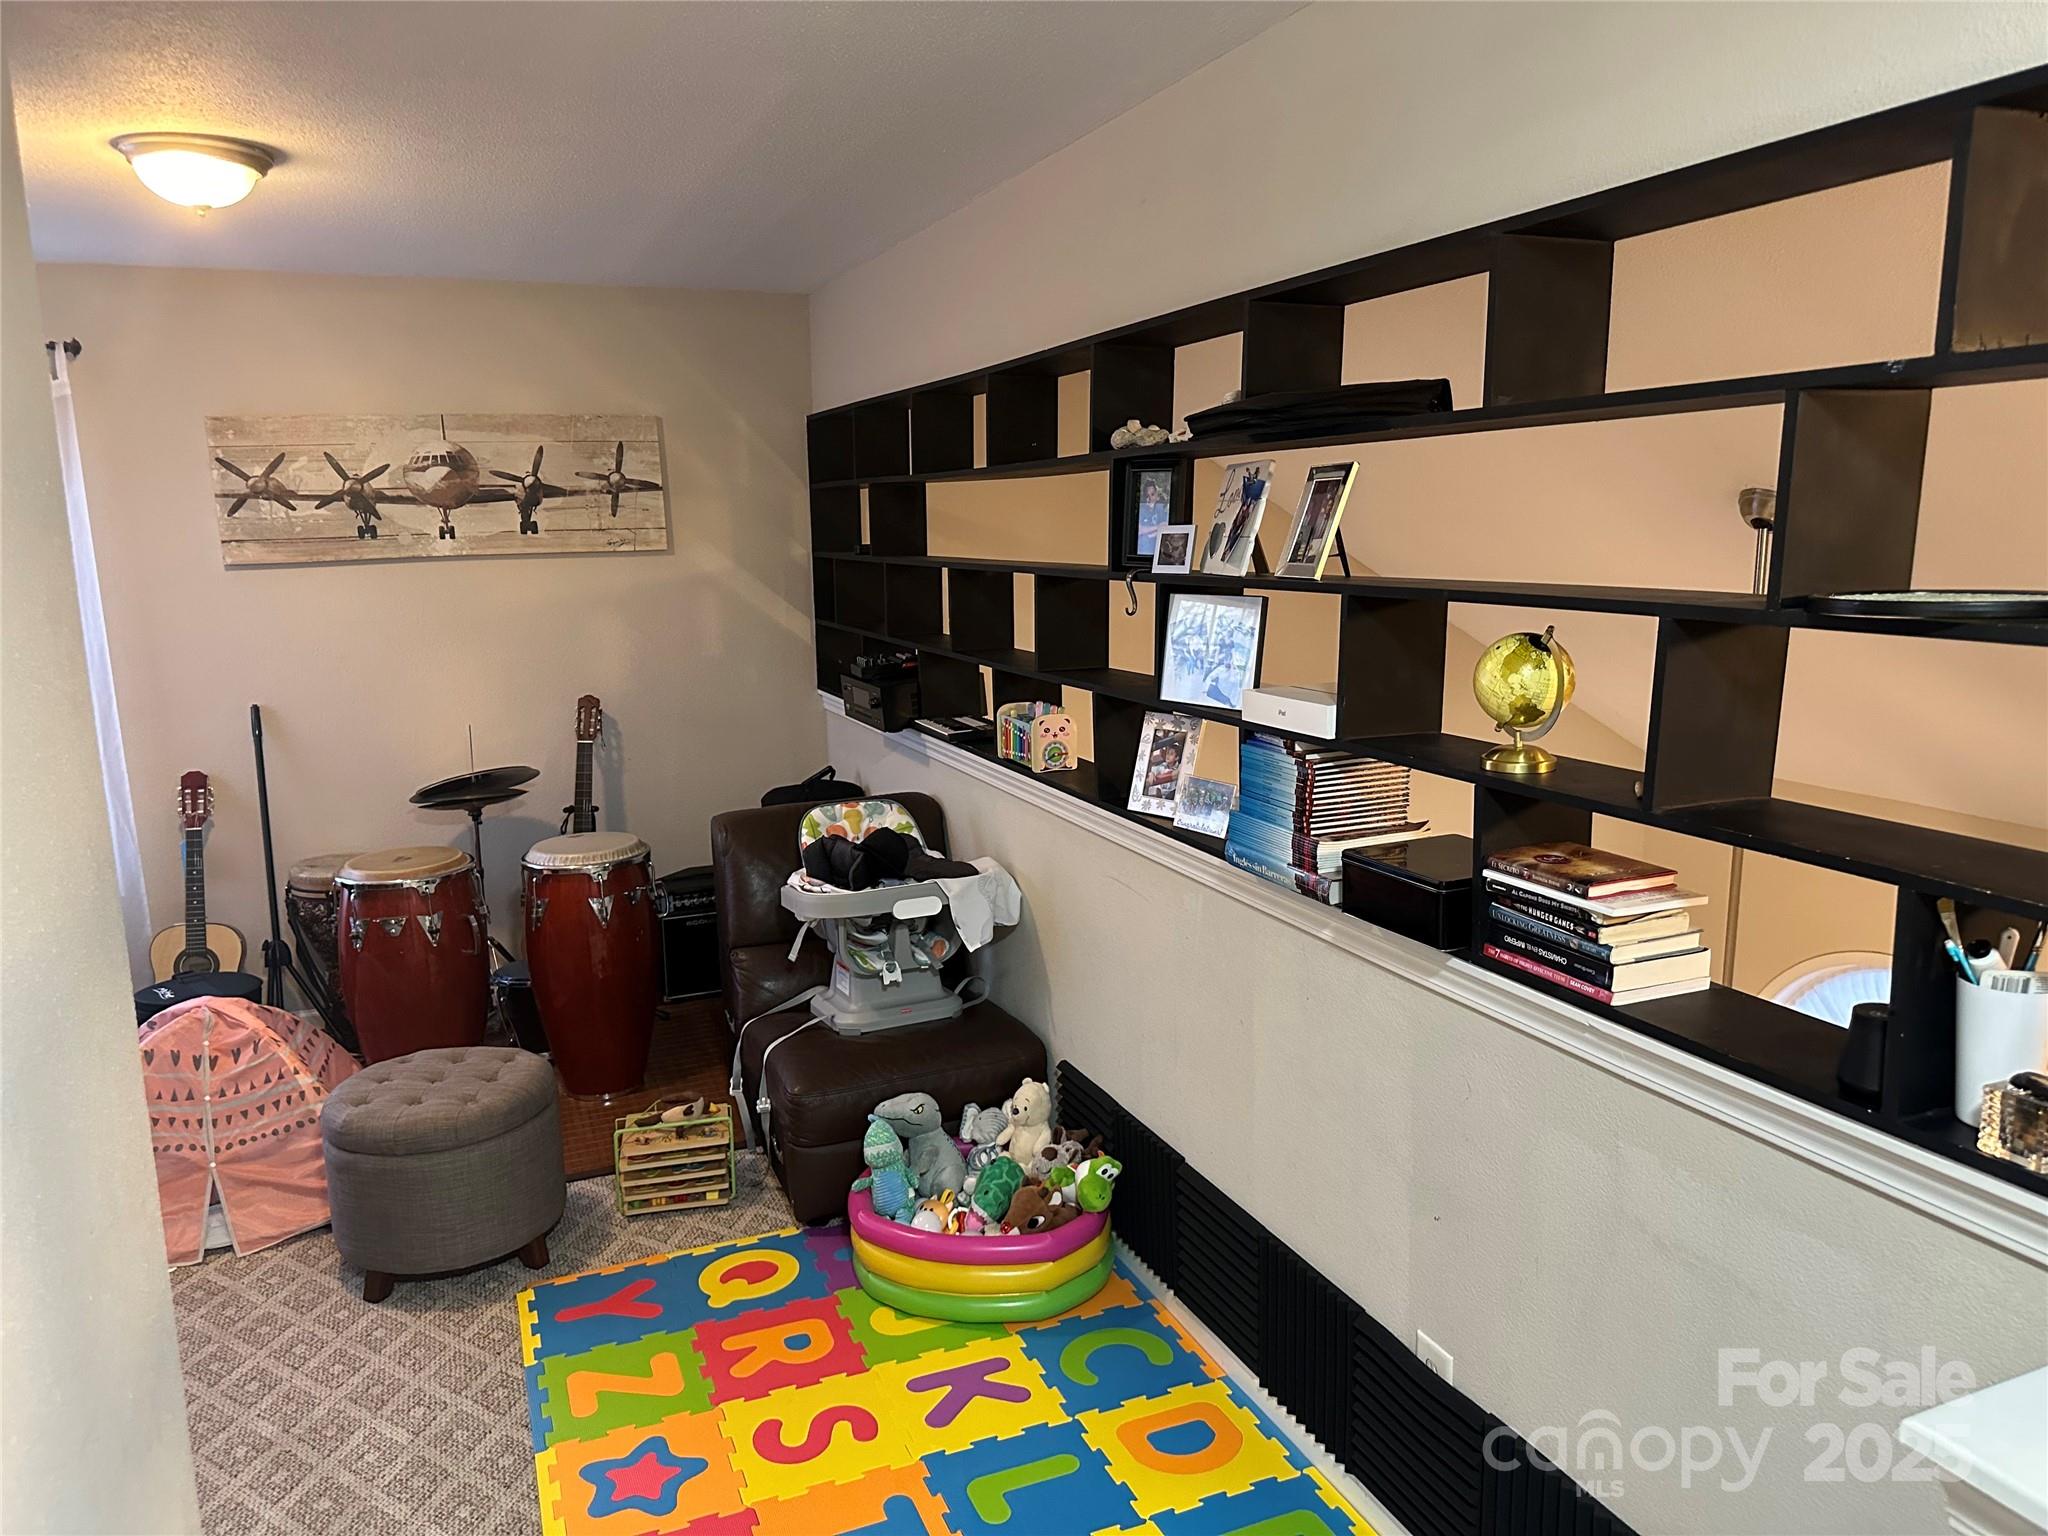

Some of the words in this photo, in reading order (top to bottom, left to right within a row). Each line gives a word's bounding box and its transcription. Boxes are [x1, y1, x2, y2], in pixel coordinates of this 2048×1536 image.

[1498, 861, 1520, 875] SECRETO
[1511, 888, 1519, 896] AL
[1519, 890, 1538, 901] CAPONE
[1551, 900, 1560, 908] MY
[1492, 909, 1528, 930] UNLOCKING
[1528, 922, 1566, 943] GREATNESS
[1528, 906, 1553, 922] HUNGER
[1553, 915, 1574, 930] GAMES
[1495, 948, 1501, 958] 7
[1503, 935, 1525, 949] IMPERIO
[1538, 948, 1568, 965] CHAVISTAS
[1569, 979, 1581, 989] SEAN
[1580, 984, 1595, 994] COVEY
[554, 1279, 664, 1323] Y
[721, 1318, 834, 1378] R
[1060, 1328, 1174, 1386] C
[906, 1357, 1031, 1429] K
[752, 1405, 879, 1465] S
[1116, 1402, 1244, 1475] D
[967, 1454, 1081, 1524] L
